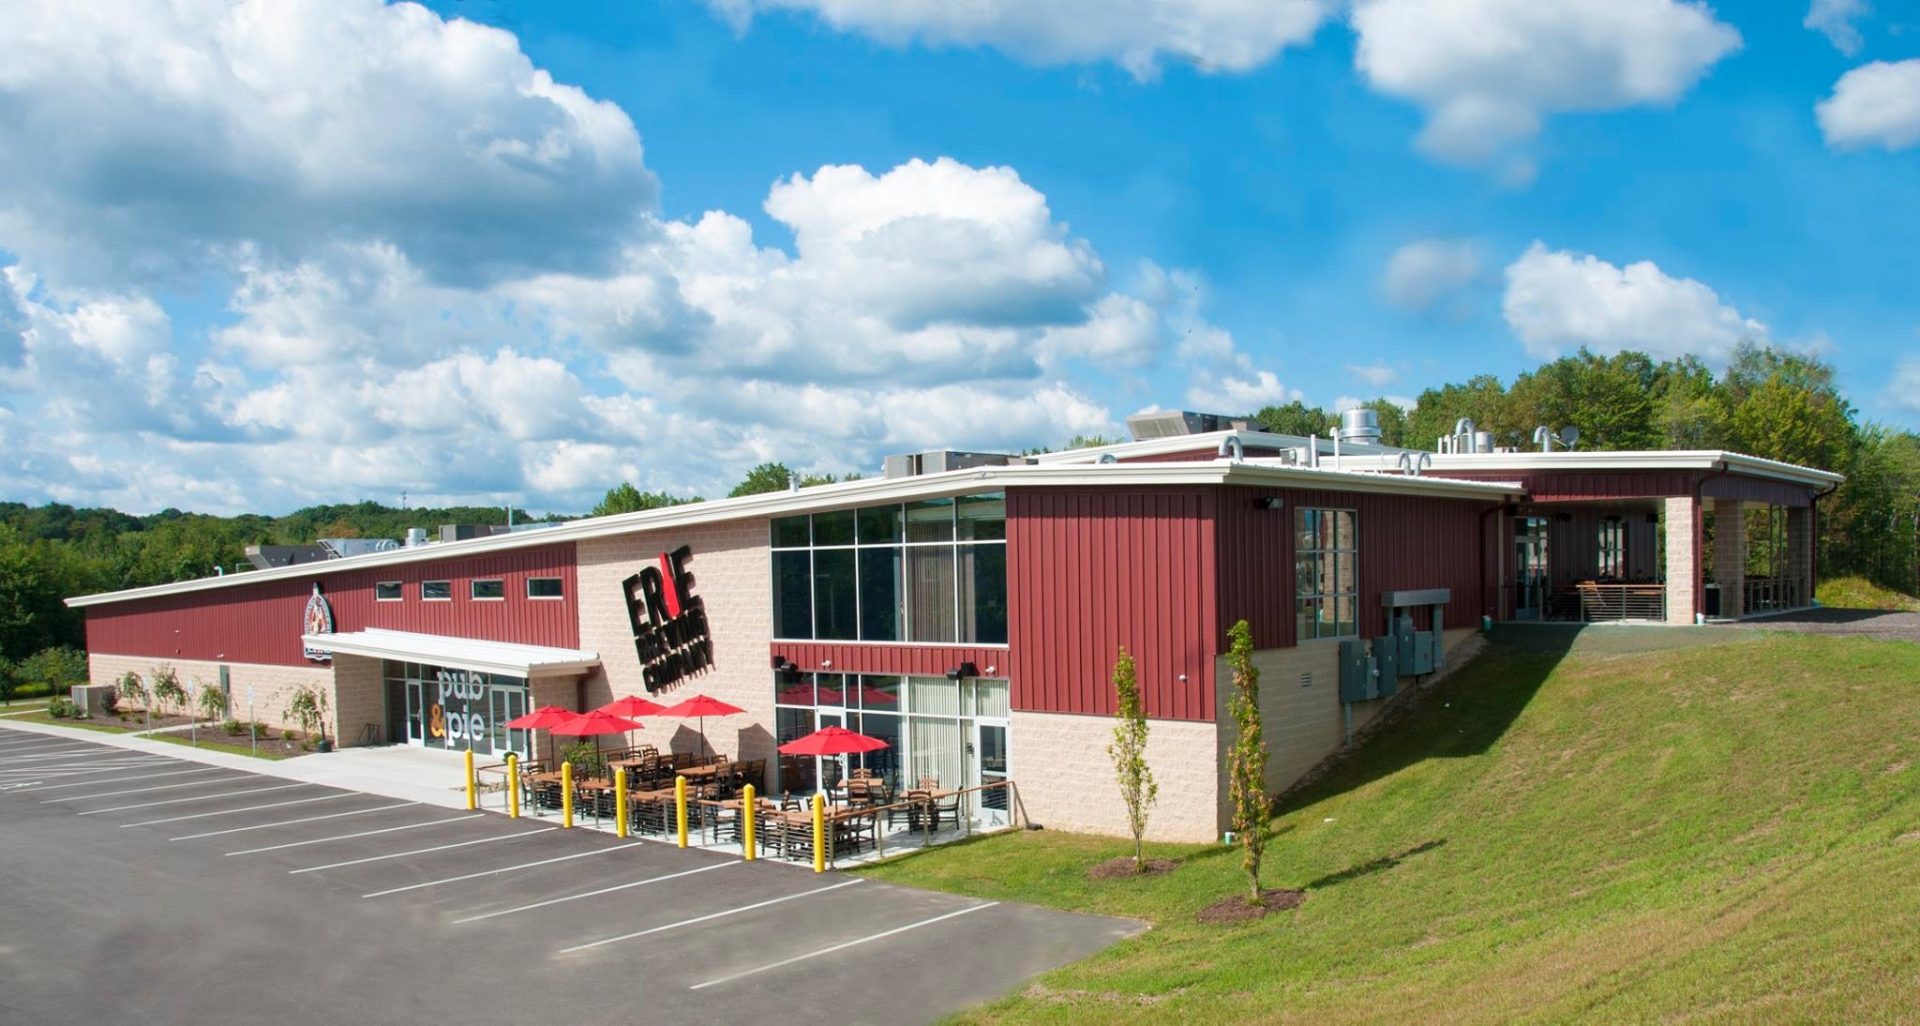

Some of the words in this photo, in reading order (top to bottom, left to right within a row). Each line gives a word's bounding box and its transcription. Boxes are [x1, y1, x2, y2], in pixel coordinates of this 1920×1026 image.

[622, 545, 700, 637] ERIE
[436, 670, 484, 705] pub
[430, 703, 446, 737] &
[446, 704, 485, 746] pie
